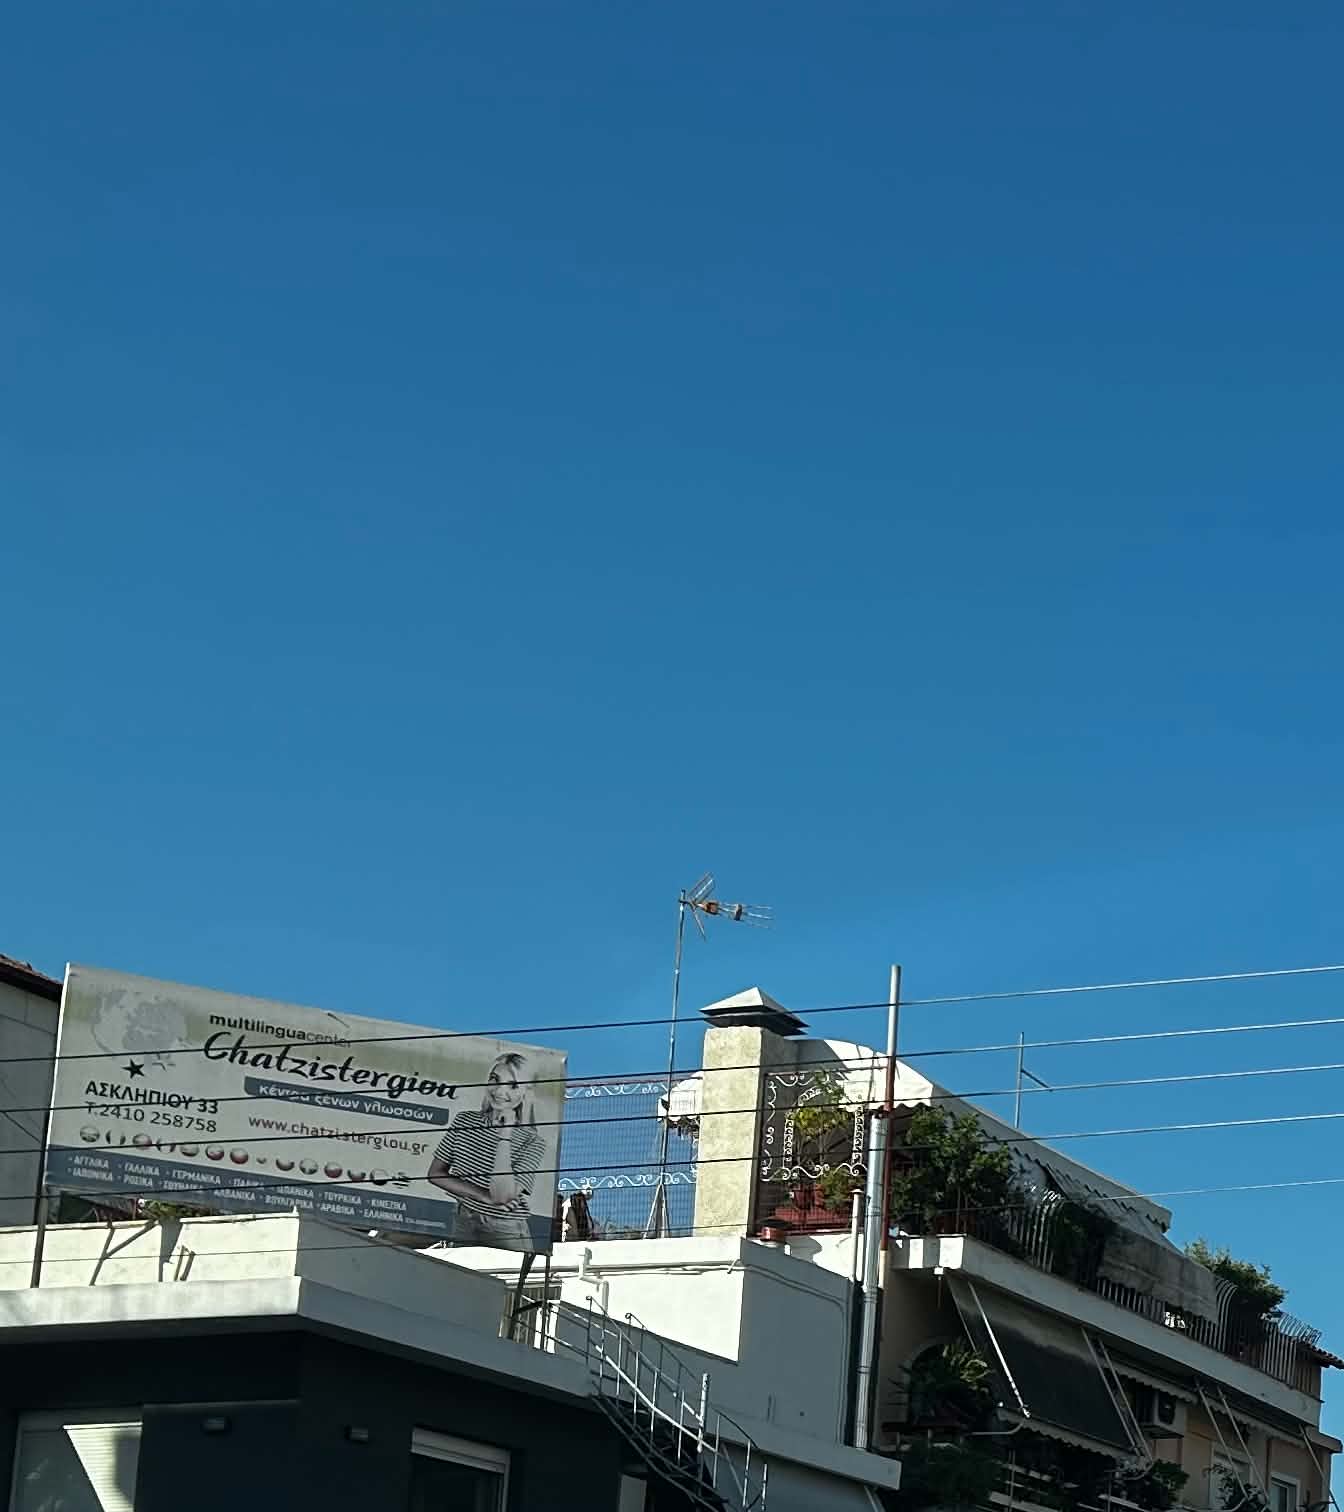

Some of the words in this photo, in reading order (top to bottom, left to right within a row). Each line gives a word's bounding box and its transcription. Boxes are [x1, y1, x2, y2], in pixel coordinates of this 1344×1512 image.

[203, 1031, 460, 1100] Chatzistergiou
[85, 1080, 193, 1110] ΑΣΚΛΗΠΙΟΥ
[197, 1099, 219, 1115] 33
[150, 1111, 218, 1134] 258758
[248, 1116, 430, 1156] www.chatzistergiou.gr
